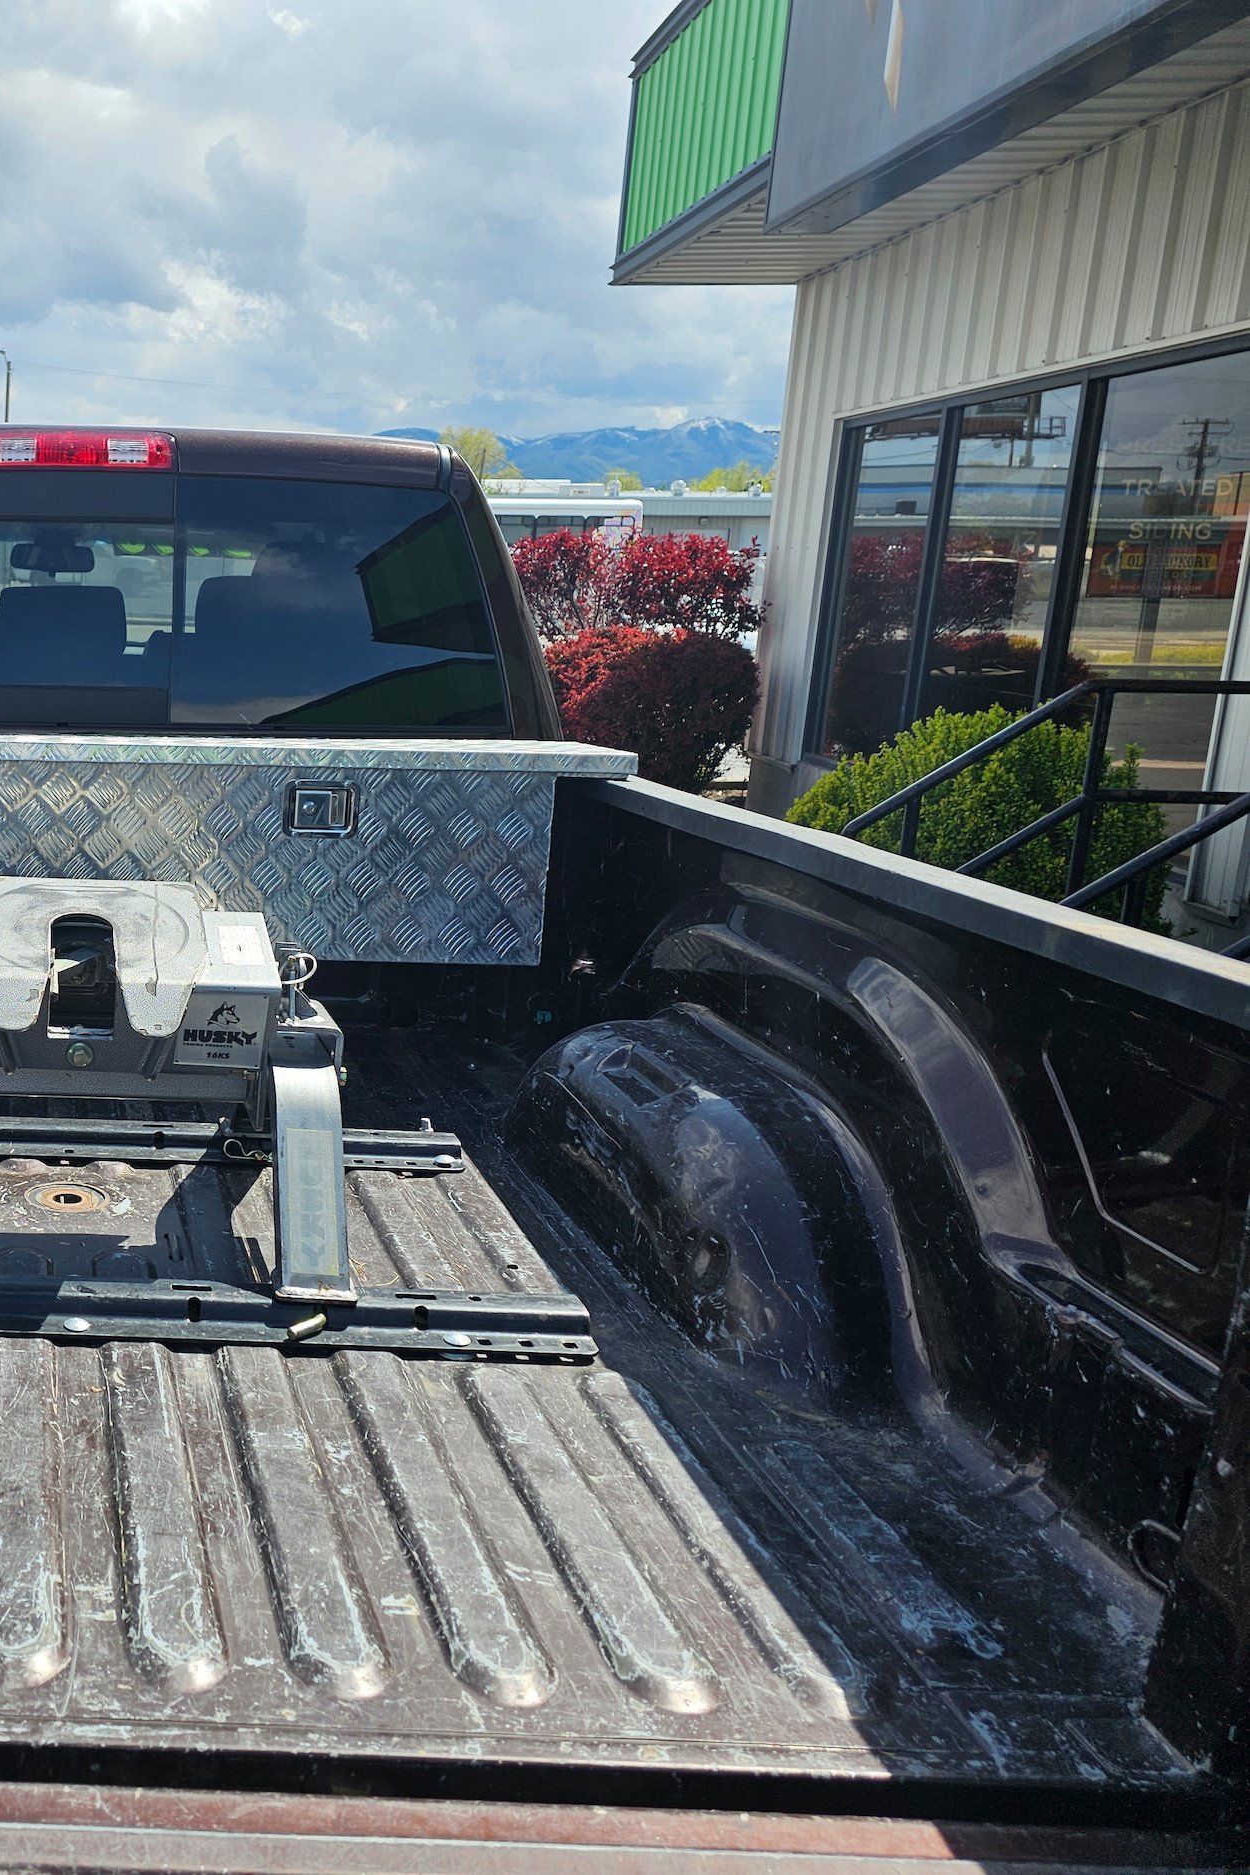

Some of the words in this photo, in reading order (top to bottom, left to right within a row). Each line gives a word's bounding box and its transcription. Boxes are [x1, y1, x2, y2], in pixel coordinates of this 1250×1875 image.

[1128, 522, 1212, 540] SIDING
[183, 1029, 257, 1046] HUSKY
[206, 1051, 231, 1059] 16KS
